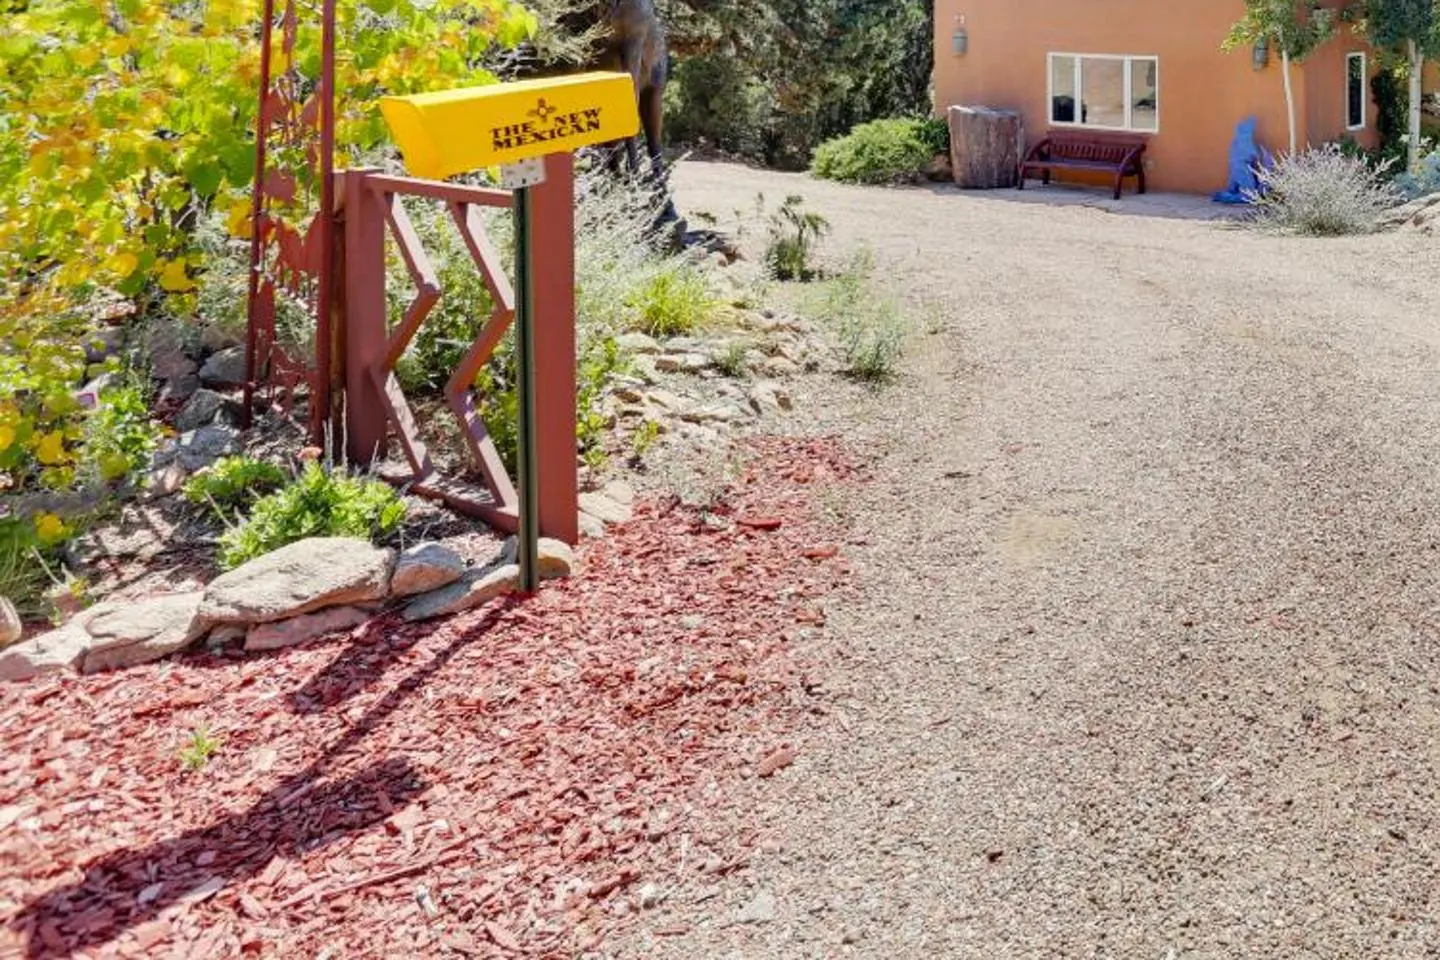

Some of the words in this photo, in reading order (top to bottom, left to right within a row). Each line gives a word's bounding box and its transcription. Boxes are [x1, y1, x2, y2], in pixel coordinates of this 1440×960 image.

[490, 121, 533, 139] THE
[554, 107, 601, 127] NEW
[492, 119, 600, 152] MEXICAN
